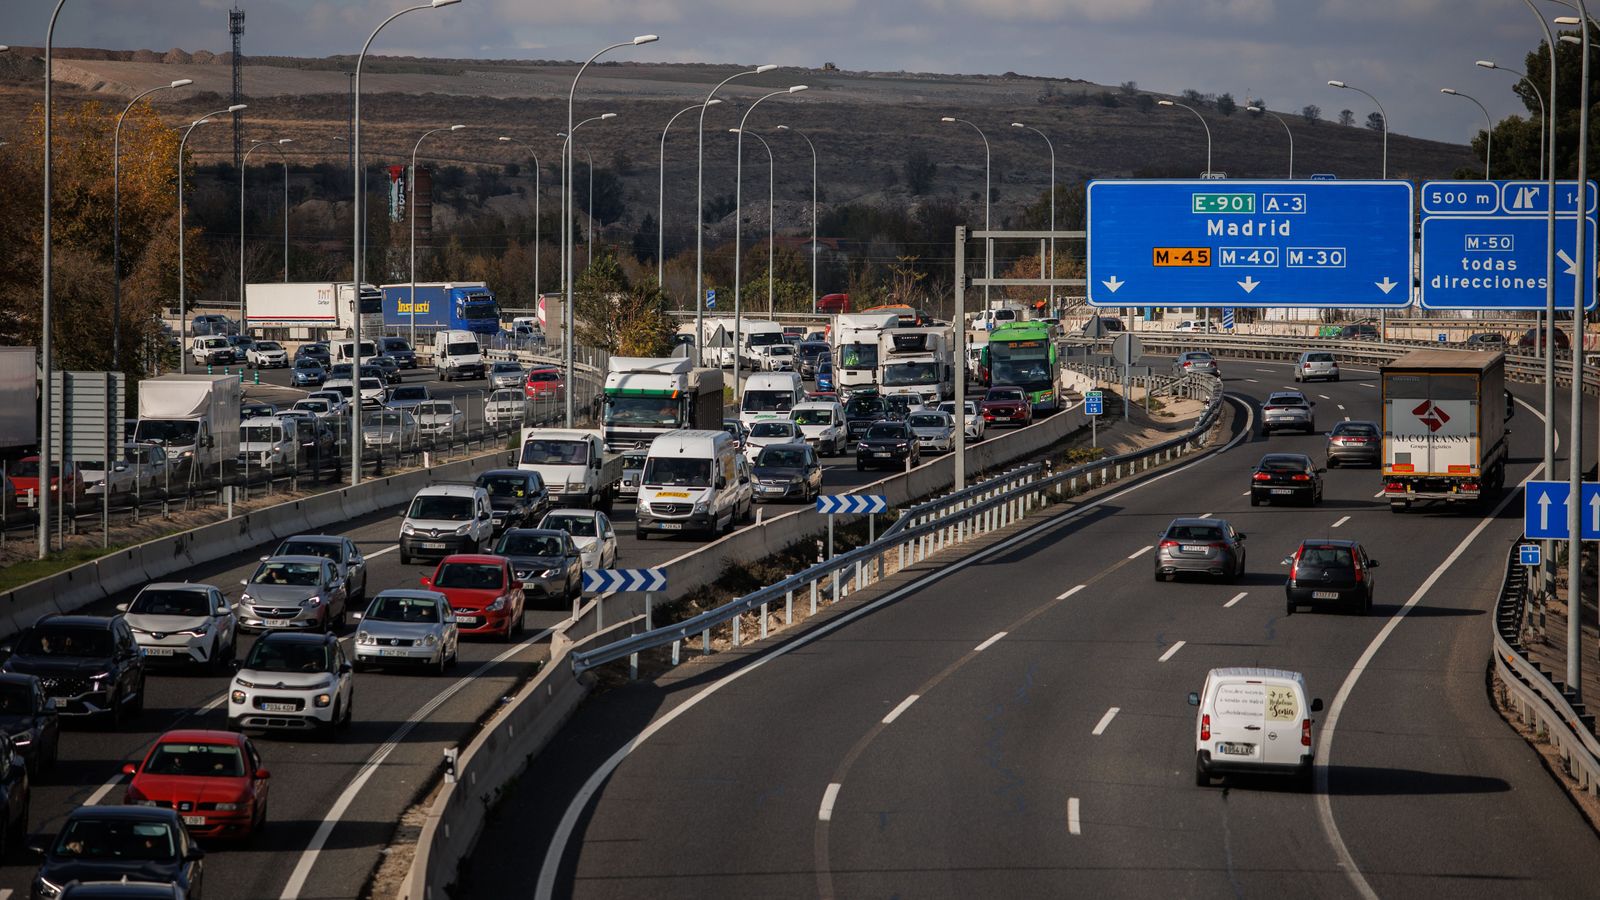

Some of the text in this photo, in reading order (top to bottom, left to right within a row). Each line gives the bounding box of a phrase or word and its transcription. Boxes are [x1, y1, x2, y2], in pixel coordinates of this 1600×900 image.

[1194, 196, 1303, 211] E-901 A-3
[1432, 192, 1490, 204] 500 m
[1207, 219, 1291, 237] Madrid
[1467, 237, 1511, 249] M-50
[1156, 250, 1342, 264] M-45 M-40 M-30
[1461, 257, 1517, 271] todas
[1431, 275, 1547, 289] direcciones
[1393, 435, 1469, 443] ALCOTRANSA
[1528, 554, 1533, 562] 1
